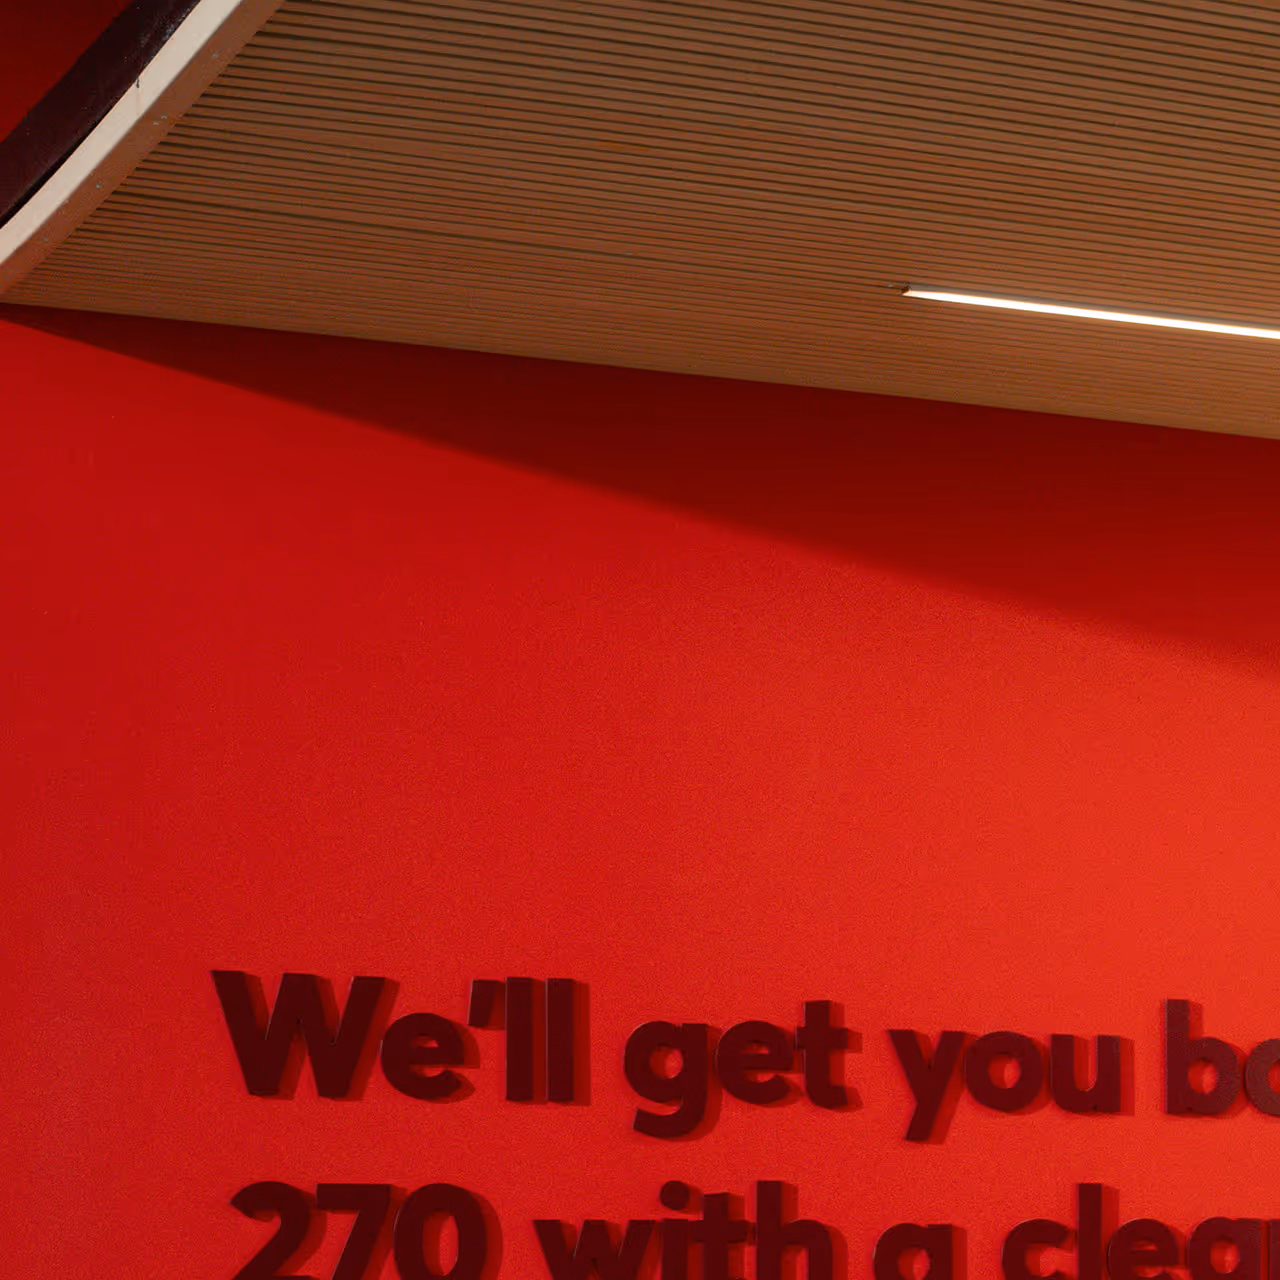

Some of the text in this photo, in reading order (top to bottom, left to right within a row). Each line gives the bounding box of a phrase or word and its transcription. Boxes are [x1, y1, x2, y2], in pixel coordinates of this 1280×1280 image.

[210, 970, 577, 1102] We'll
[622, 1000, 855, 1138] get
[885, 1028, 1122, 1142] you
